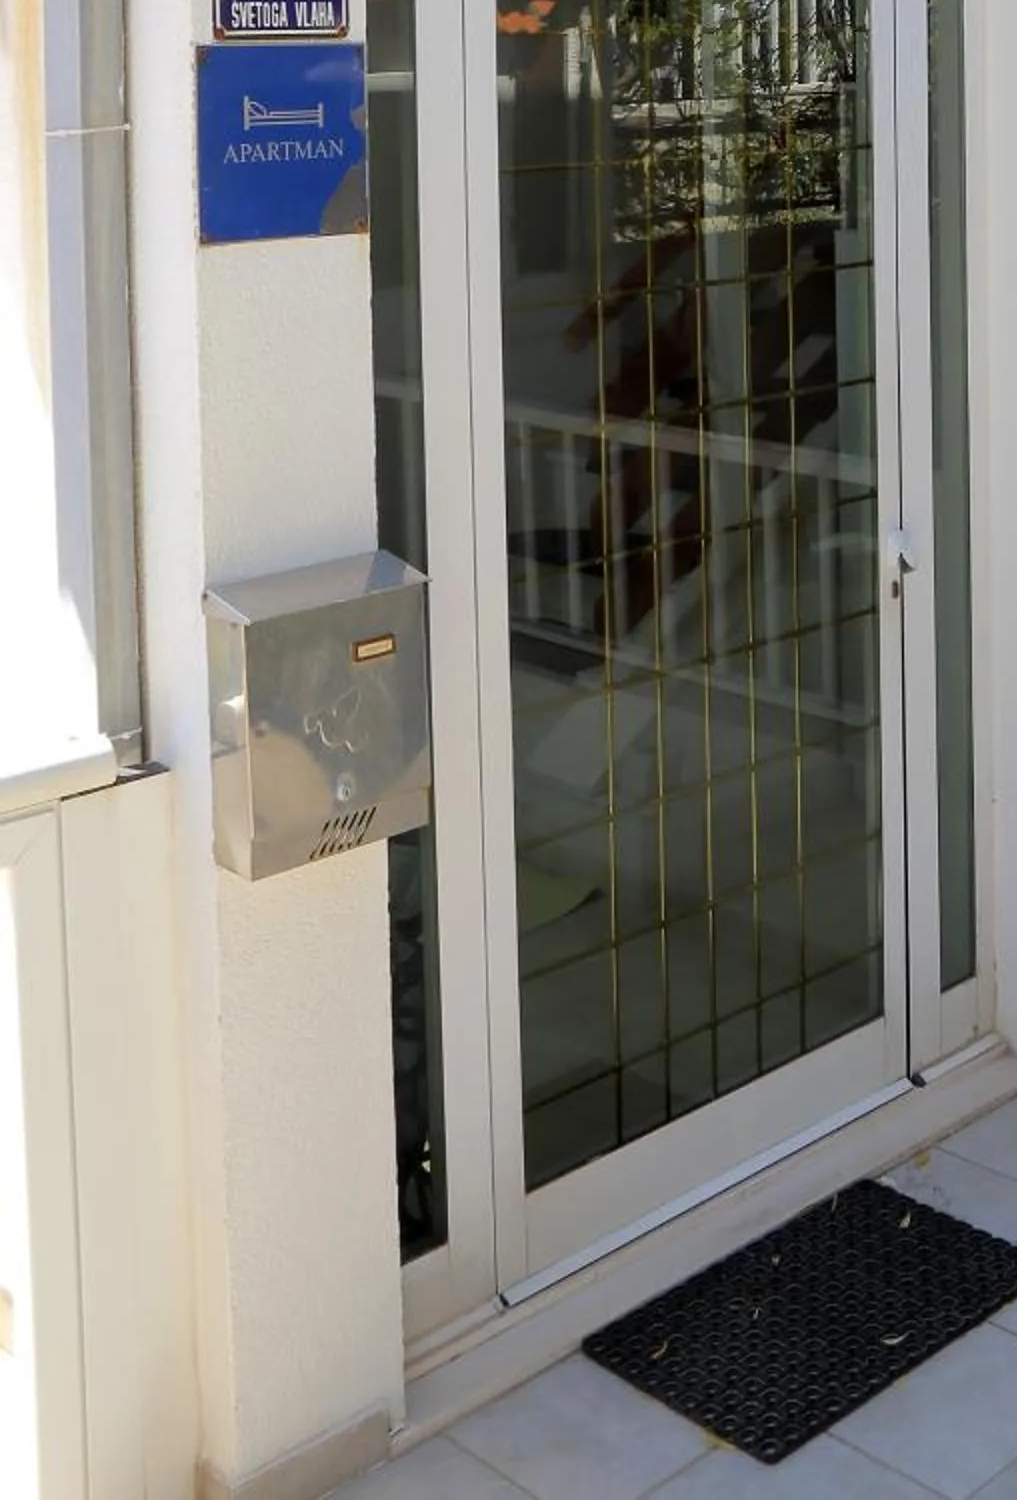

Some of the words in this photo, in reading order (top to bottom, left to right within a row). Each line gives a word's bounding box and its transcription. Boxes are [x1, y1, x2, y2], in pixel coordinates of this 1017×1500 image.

[231, 1, 288, 28] SVETOGA
[295, 1, 336, 27] VLAHA
[223, 138, 344, 164] APARTMAN
